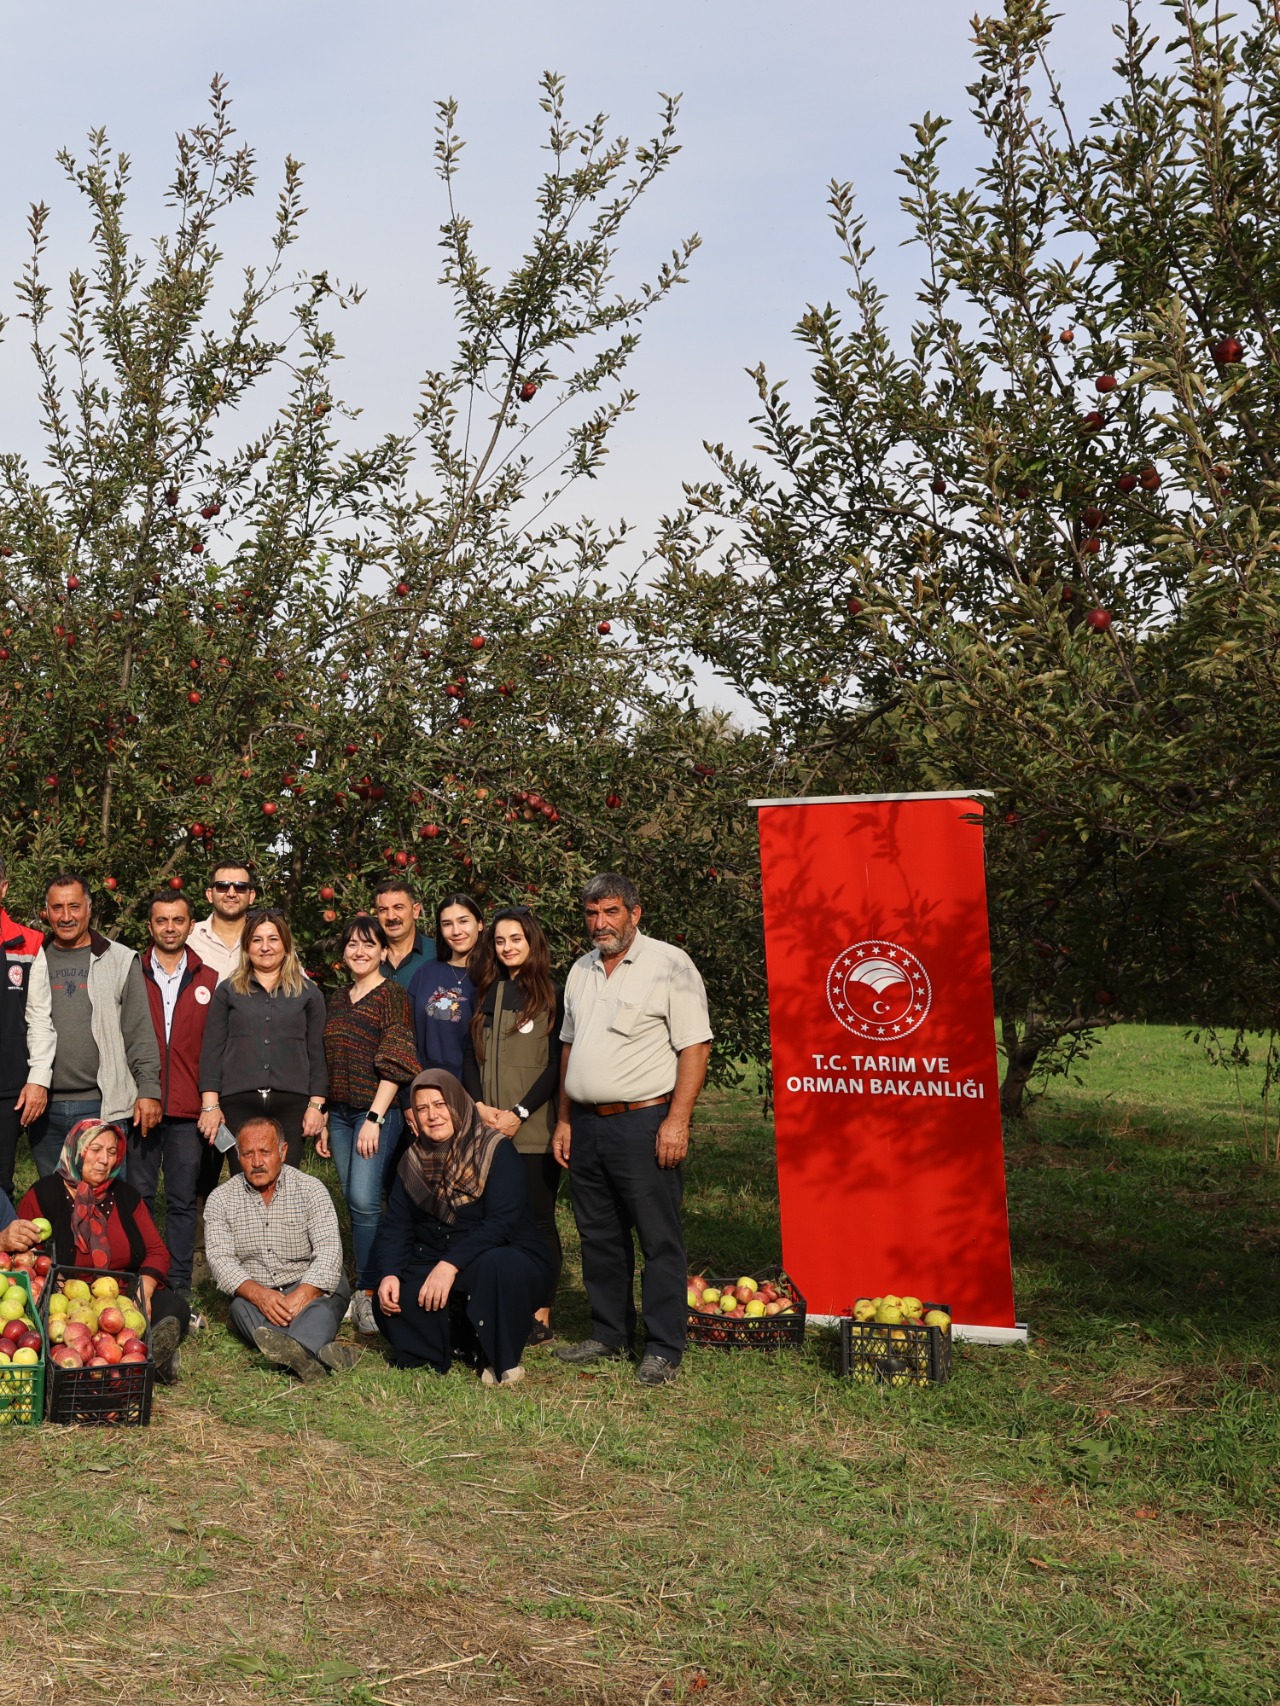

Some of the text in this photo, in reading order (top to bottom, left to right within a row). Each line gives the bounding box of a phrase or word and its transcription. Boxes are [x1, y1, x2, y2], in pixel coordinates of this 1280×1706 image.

[56, 967, 77, 978] POLO
[812, 1054, 950, 1074] T.C. TARIM VE
[786, 1076, 985, 1099] ORMAN BAKANLIĞI
